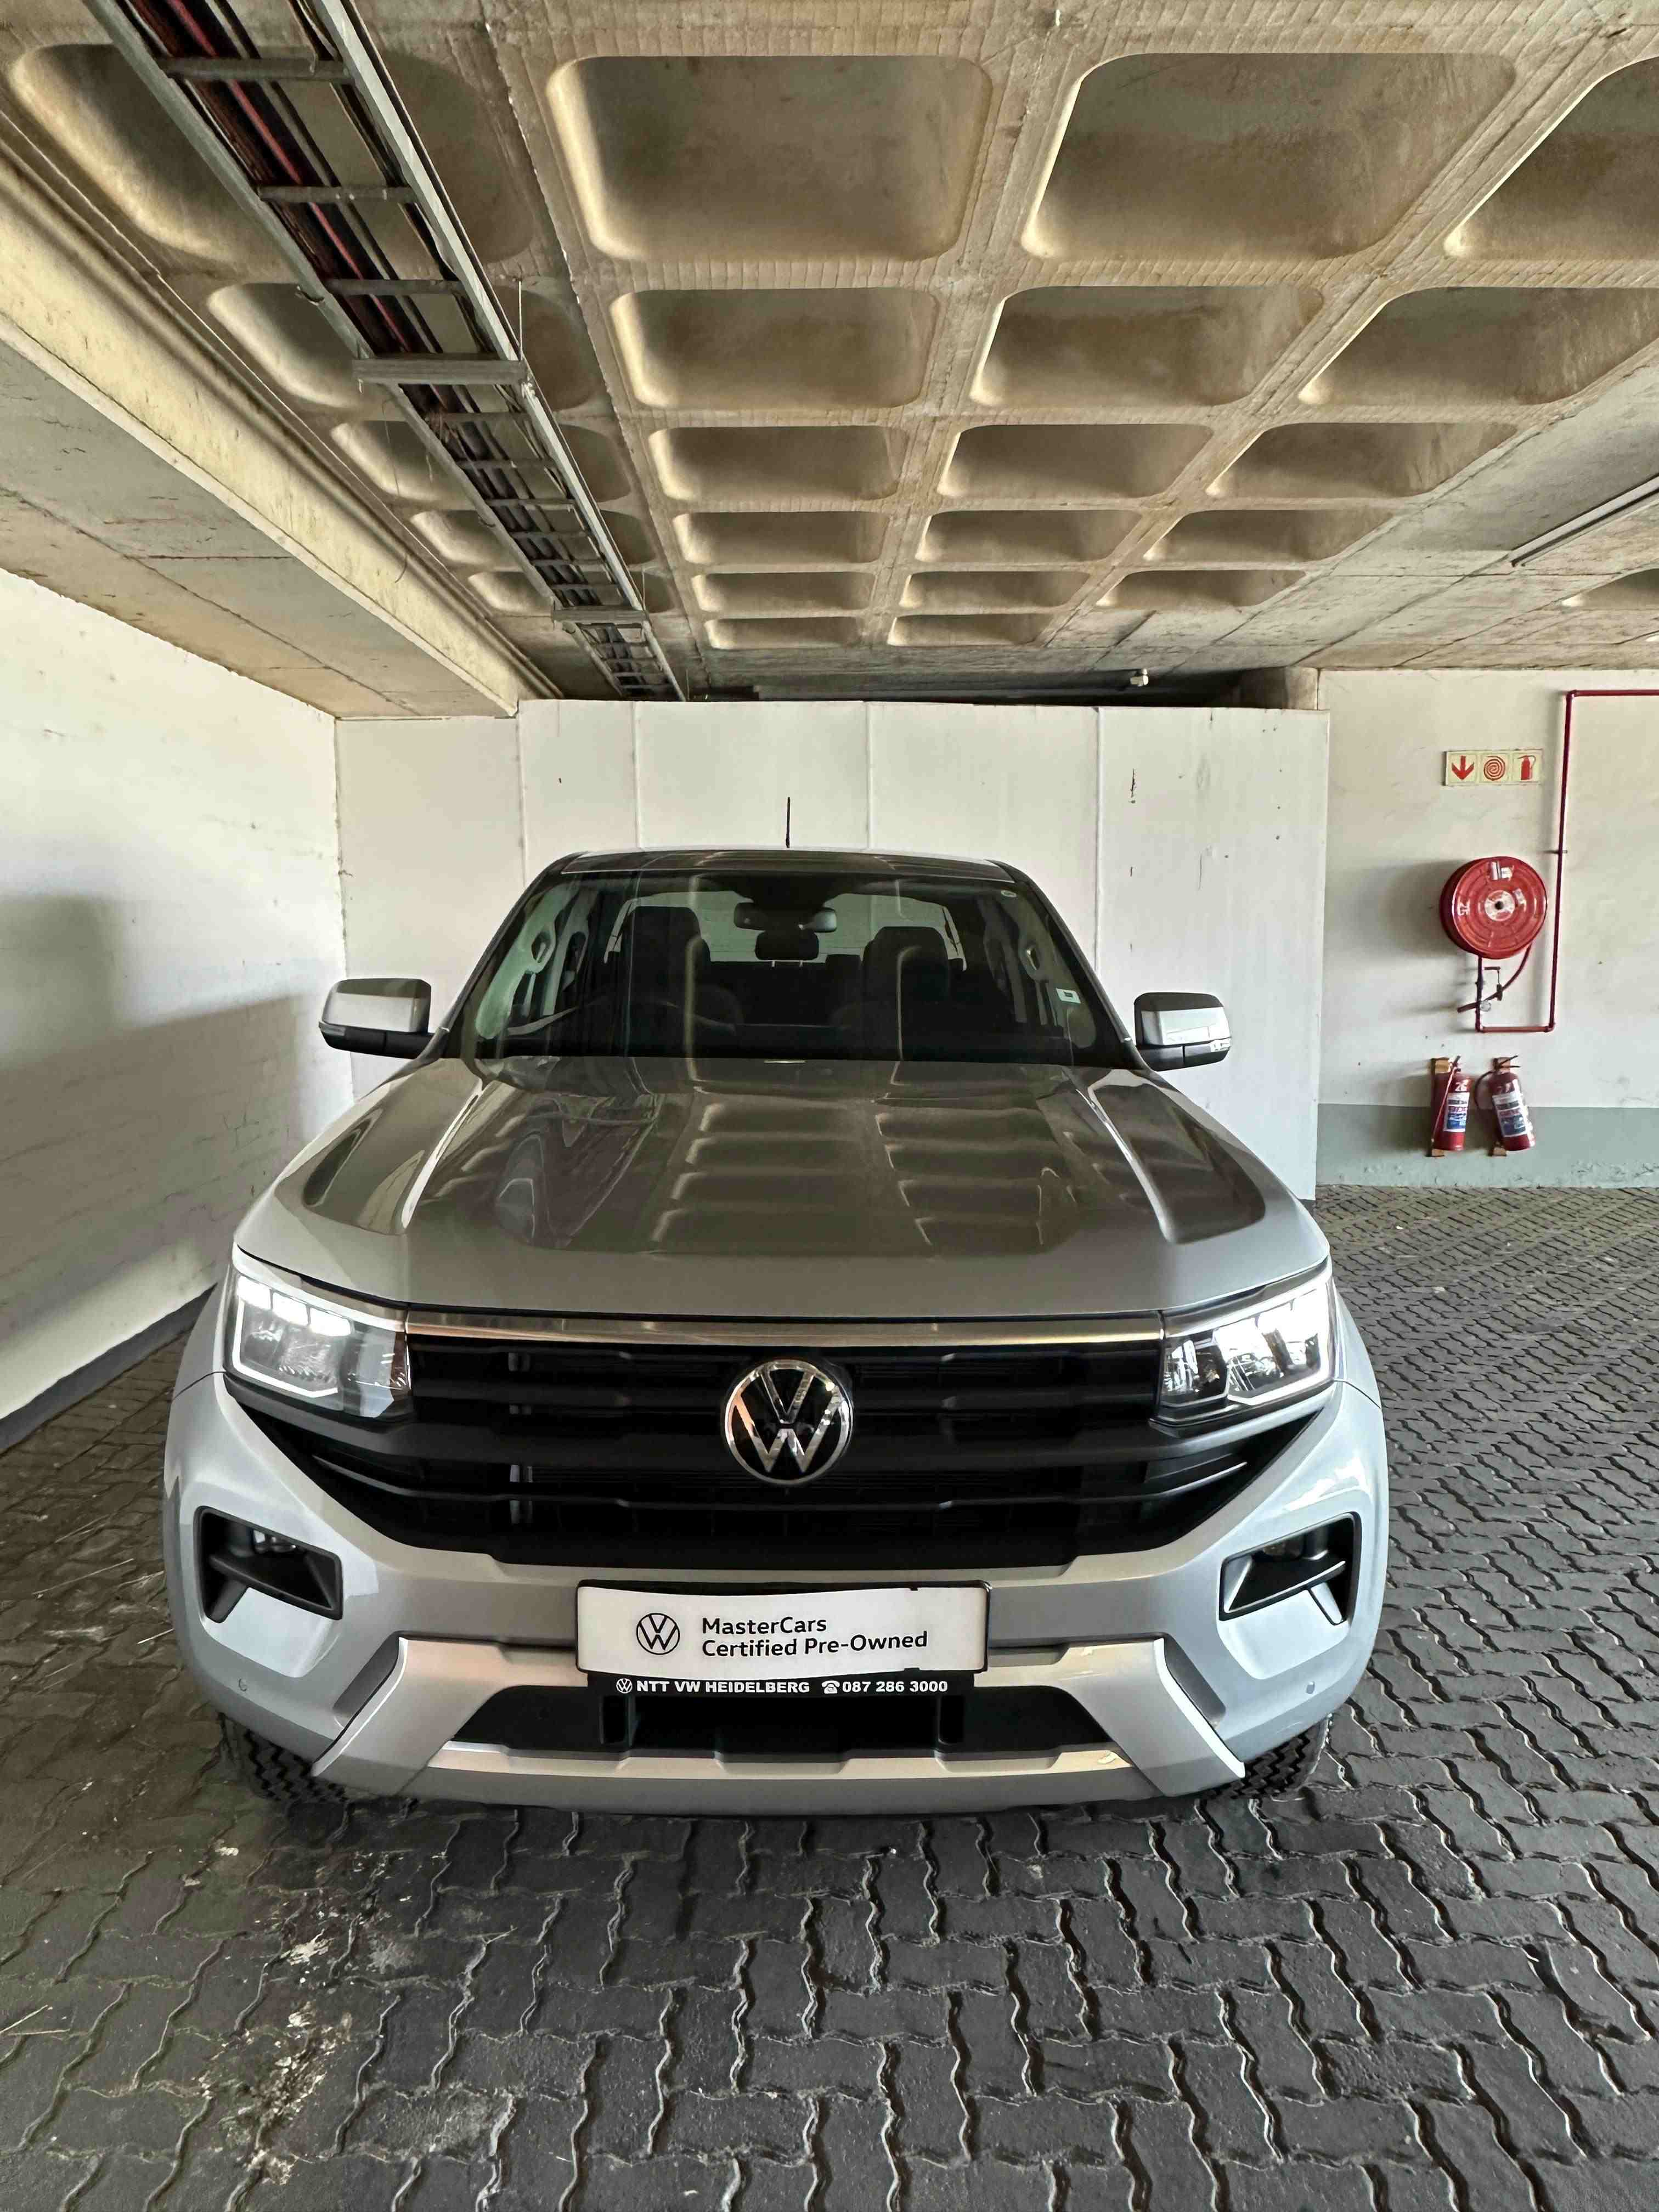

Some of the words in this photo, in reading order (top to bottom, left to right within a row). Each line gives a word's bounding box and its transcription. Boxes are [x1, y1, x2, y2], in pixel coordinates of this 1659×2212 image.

[727, 1361, 848, 1479] VW
[636, 1613, 680, 1655] VW
[702, 1616, 827, 1635] MasterCars
[702, 1638, 797, 1657] Certified
[804, 1630, 928, 1655] Pre-Owned
[636, 1680, 670, 1692] NTT
[674, 1681, 701, 1692] VW
[705, 1681, 810, 1694] HEIDELBERG
[842, 1680, 871, 1692] 087
[876, 1680, 905, 1692] 286
[909, 1680, 948, 1692] 3000
